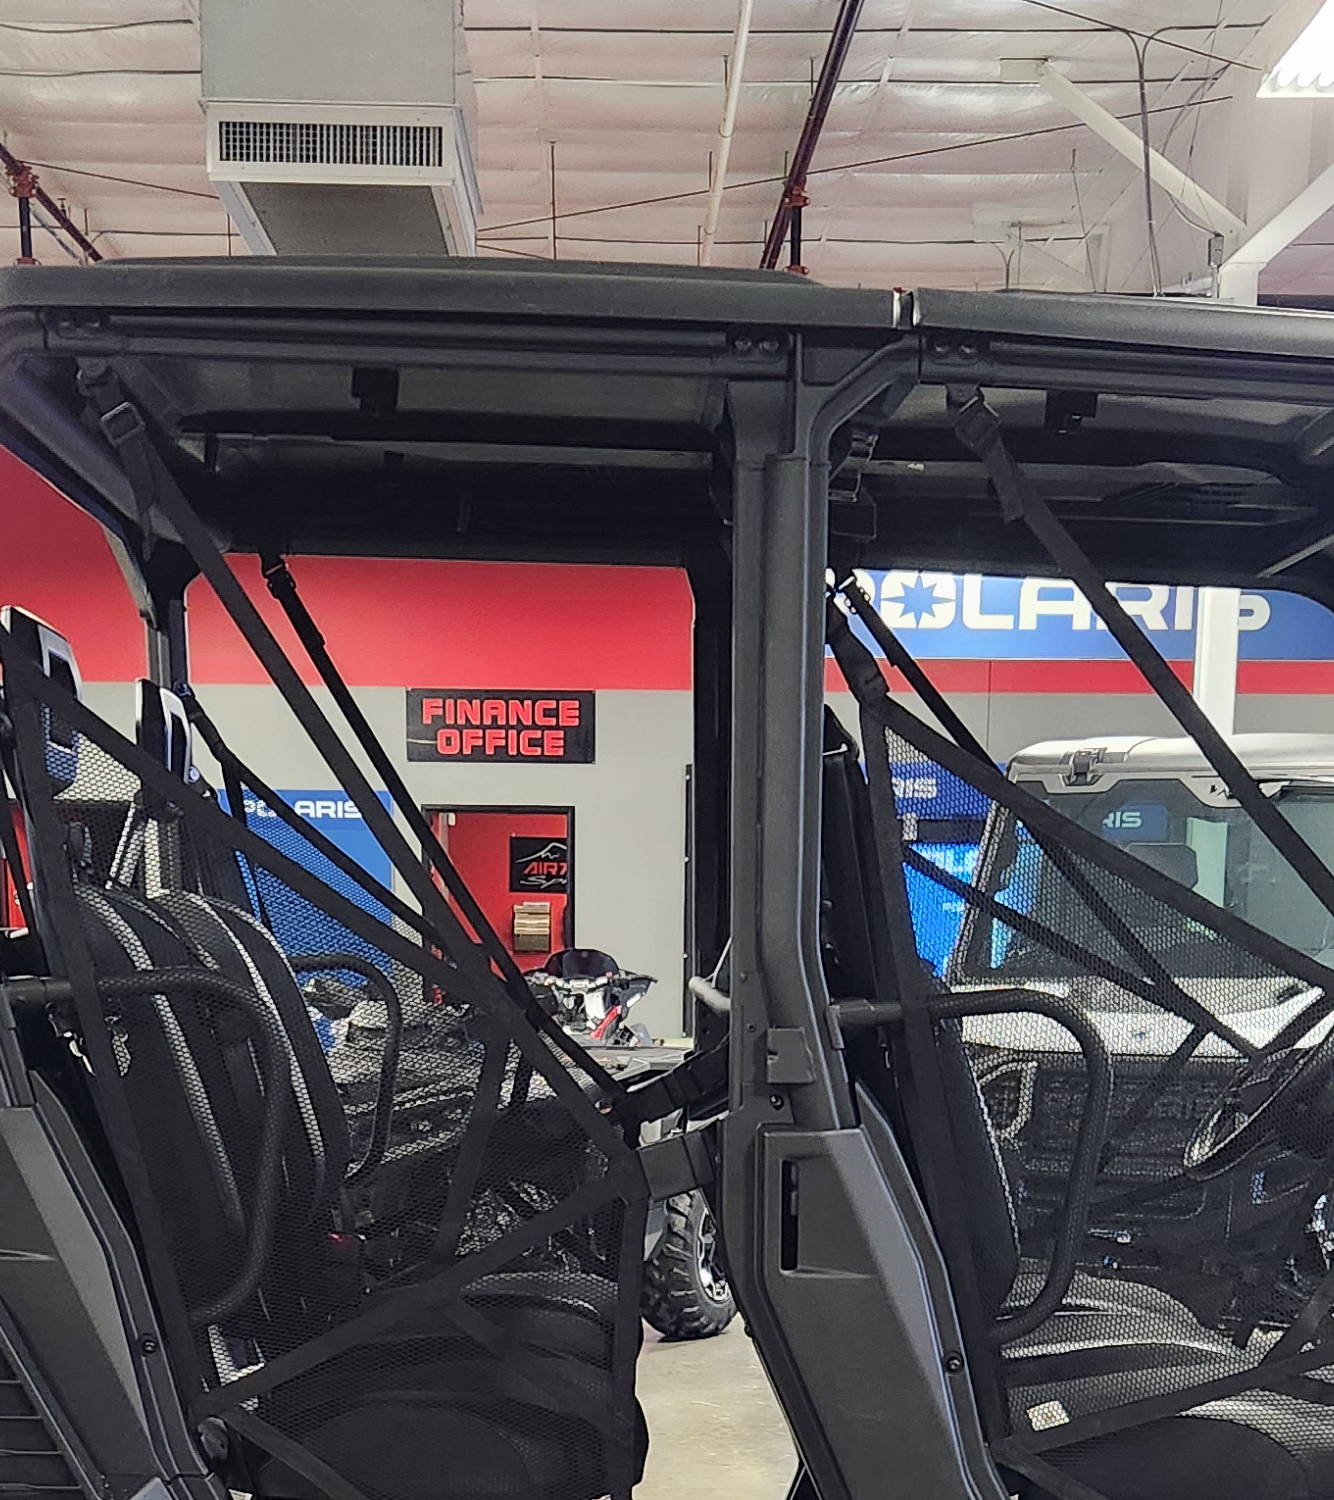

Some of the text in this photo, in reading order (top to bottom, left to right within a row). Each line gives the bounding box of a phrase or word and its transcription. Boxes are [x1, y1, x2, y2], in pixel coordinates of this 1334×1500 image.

[422, 698, 580, 726] FINANCE
[437, 728, 564, 756] OFFICE
[243, 799, 363, 819] OARIS
